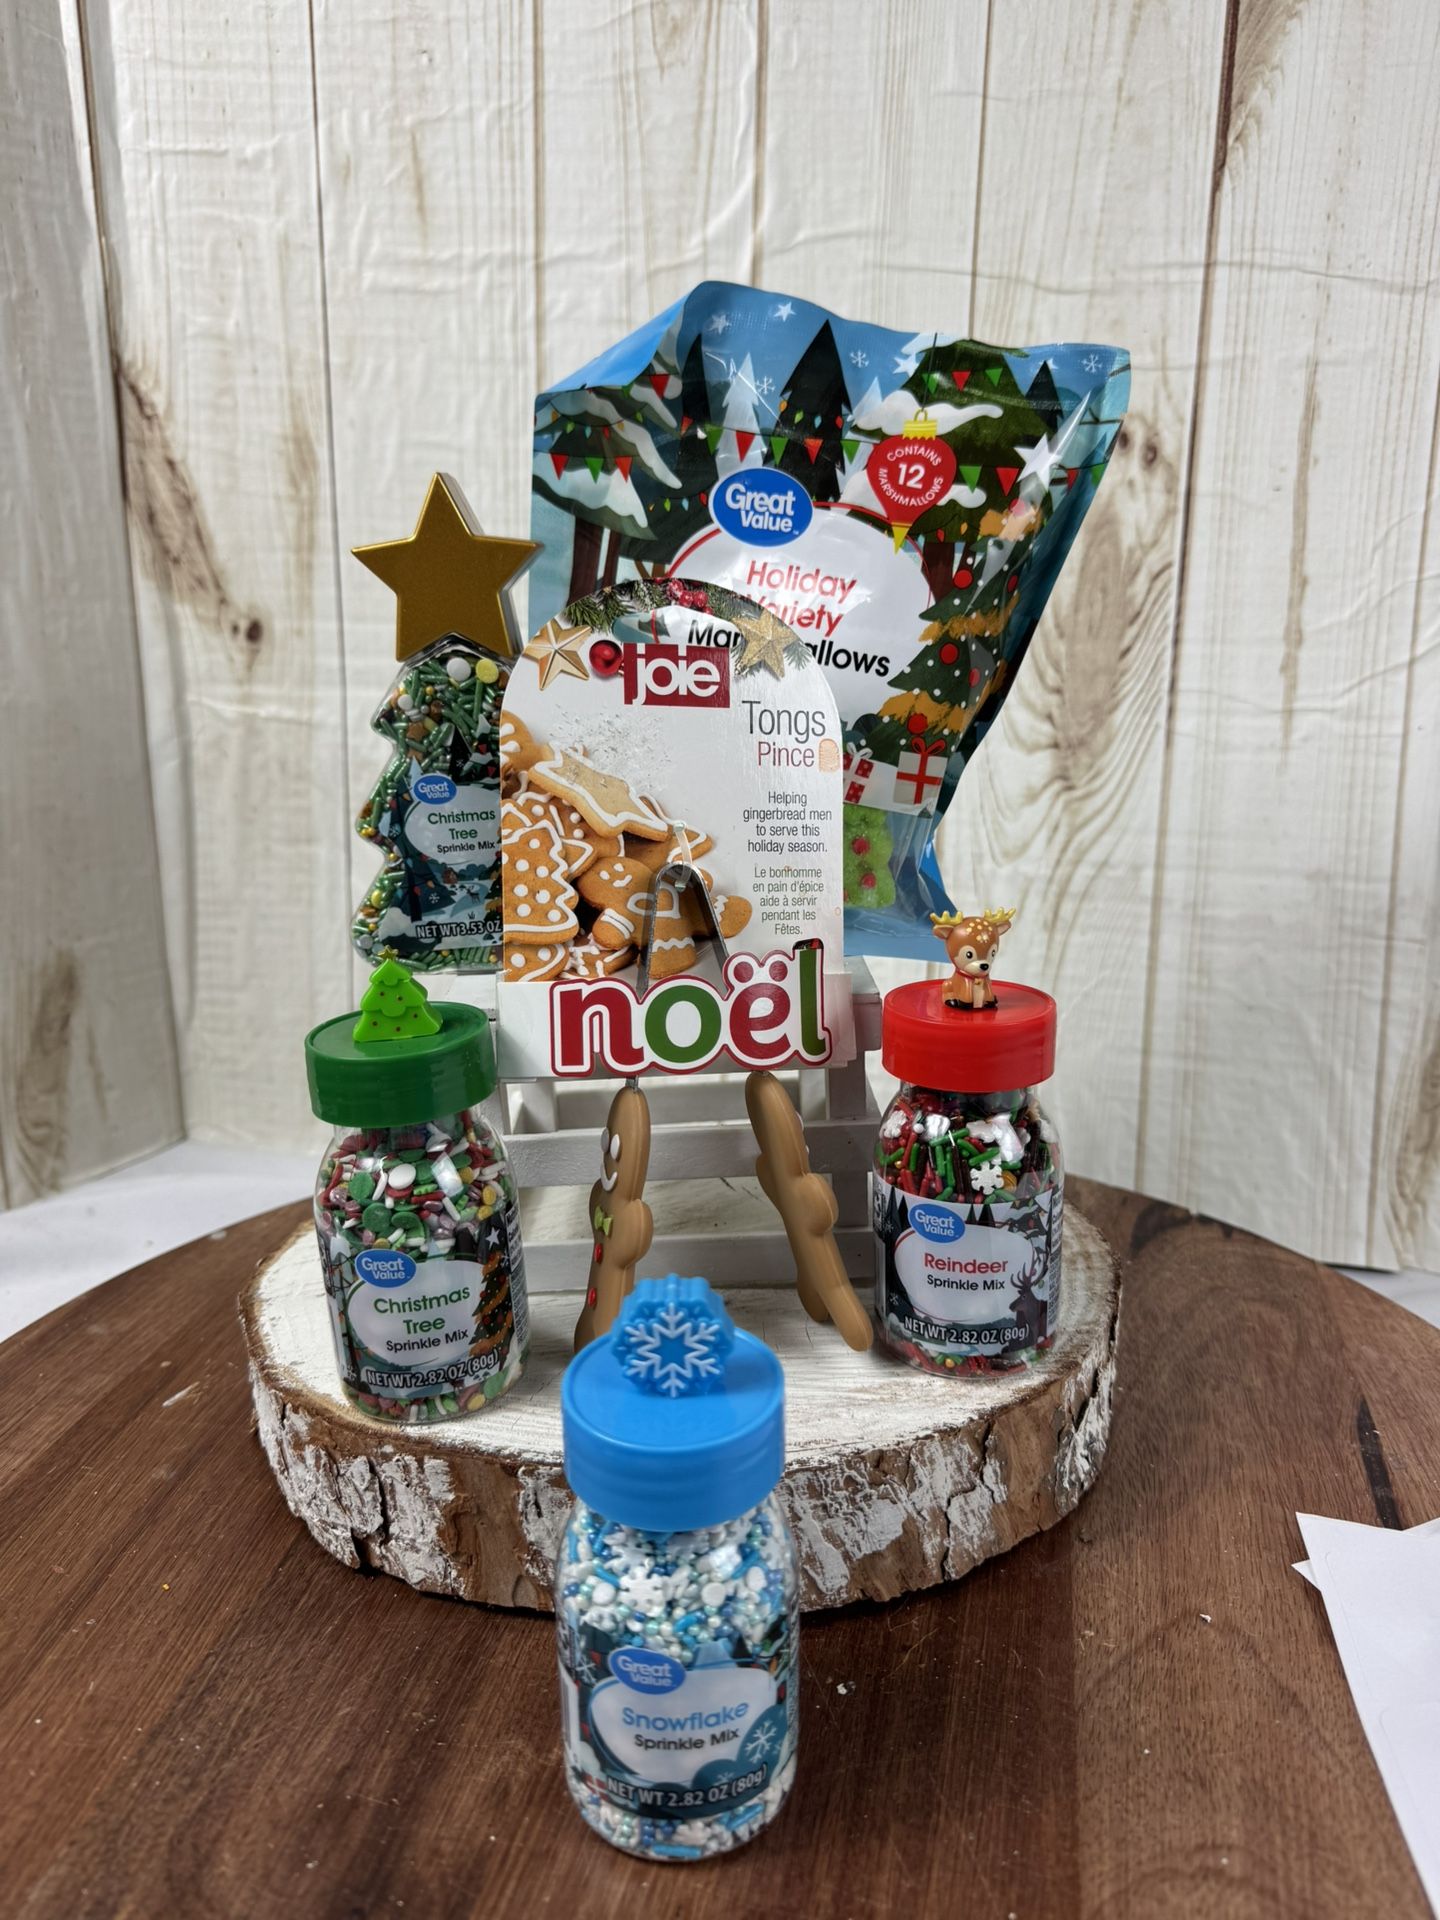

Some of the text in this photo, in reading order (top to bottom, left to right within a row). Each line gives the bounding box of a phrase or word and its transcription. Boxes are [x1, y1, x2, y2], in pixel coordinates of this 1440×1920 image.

[887, 445, 942, 466] CONTAINS
[898, 462, 925, 490] 12
[878, 467, 944, 507] MARSHMALLOWS
[725, 483, 796, 516] Great
[740, 510, 793, 533] Value
[746, 560, 858, 604] Holiday
[632, 643, 720, 706] joie
[741, 700, 826, 744] Tongs
[758, 741, 815, 767] Pince
[417, 781, 450, 795] Great
[426, 788, 450, 799] Value
[768, 791, 808, 806] Helping
[427, 810, 496, 825] Christmas
[743, 808, 832, 823] gingerbread men
[449, 828, 478, 840] Tree
[756, 824, 820, 837] to serve this
[437, 840, 496, 854] Sprinkle Mix
[747, 839, 828, 855] holiday season.
[754, 866, 822, 878] Le bonhomme
[752, 880, 824, 894] en pain d'épice
[760, 895, 818, 907] aide à servir
[761, 909, 816, 923] pendant les
[416, 920, 502, 938] NET WT 3.53 OZ
[774, 923, 803, 935] Fêtes.
[552, 939, 831, 1078] noël
[915, 1209, 955, 1229] Great
[923, 1222, 955, 1237] Value
[361, 1257, 404, 1272] Great
[924, 1252, 1008, 1274] Reindeer
[372, 1269, 405, 1280] Value
[927, 1275, 1005, 1291] Sprinkle Mix
[373, 1286, 471, 1314] Christmas
[403, 1316, 446, 1335] Tree
[904, 1316, 1030, 1344] NET WT 2.82 OZ (80g)
[386, 1328, 469, 1353] Sprinkle Mix
[366, 1349, 499, 1388] NET WT 2.82 OZ (80g)
[617, 1655, 673, 1678] Great
[630, 1671, 673, 1687] Value
[622, 1702, 750, 1731] Snowflake
[634, 1728, 740, 1751] Sprinkle Mix
[607, 1764, 768, 1807] NET WT 2.82 OZ (80g)
